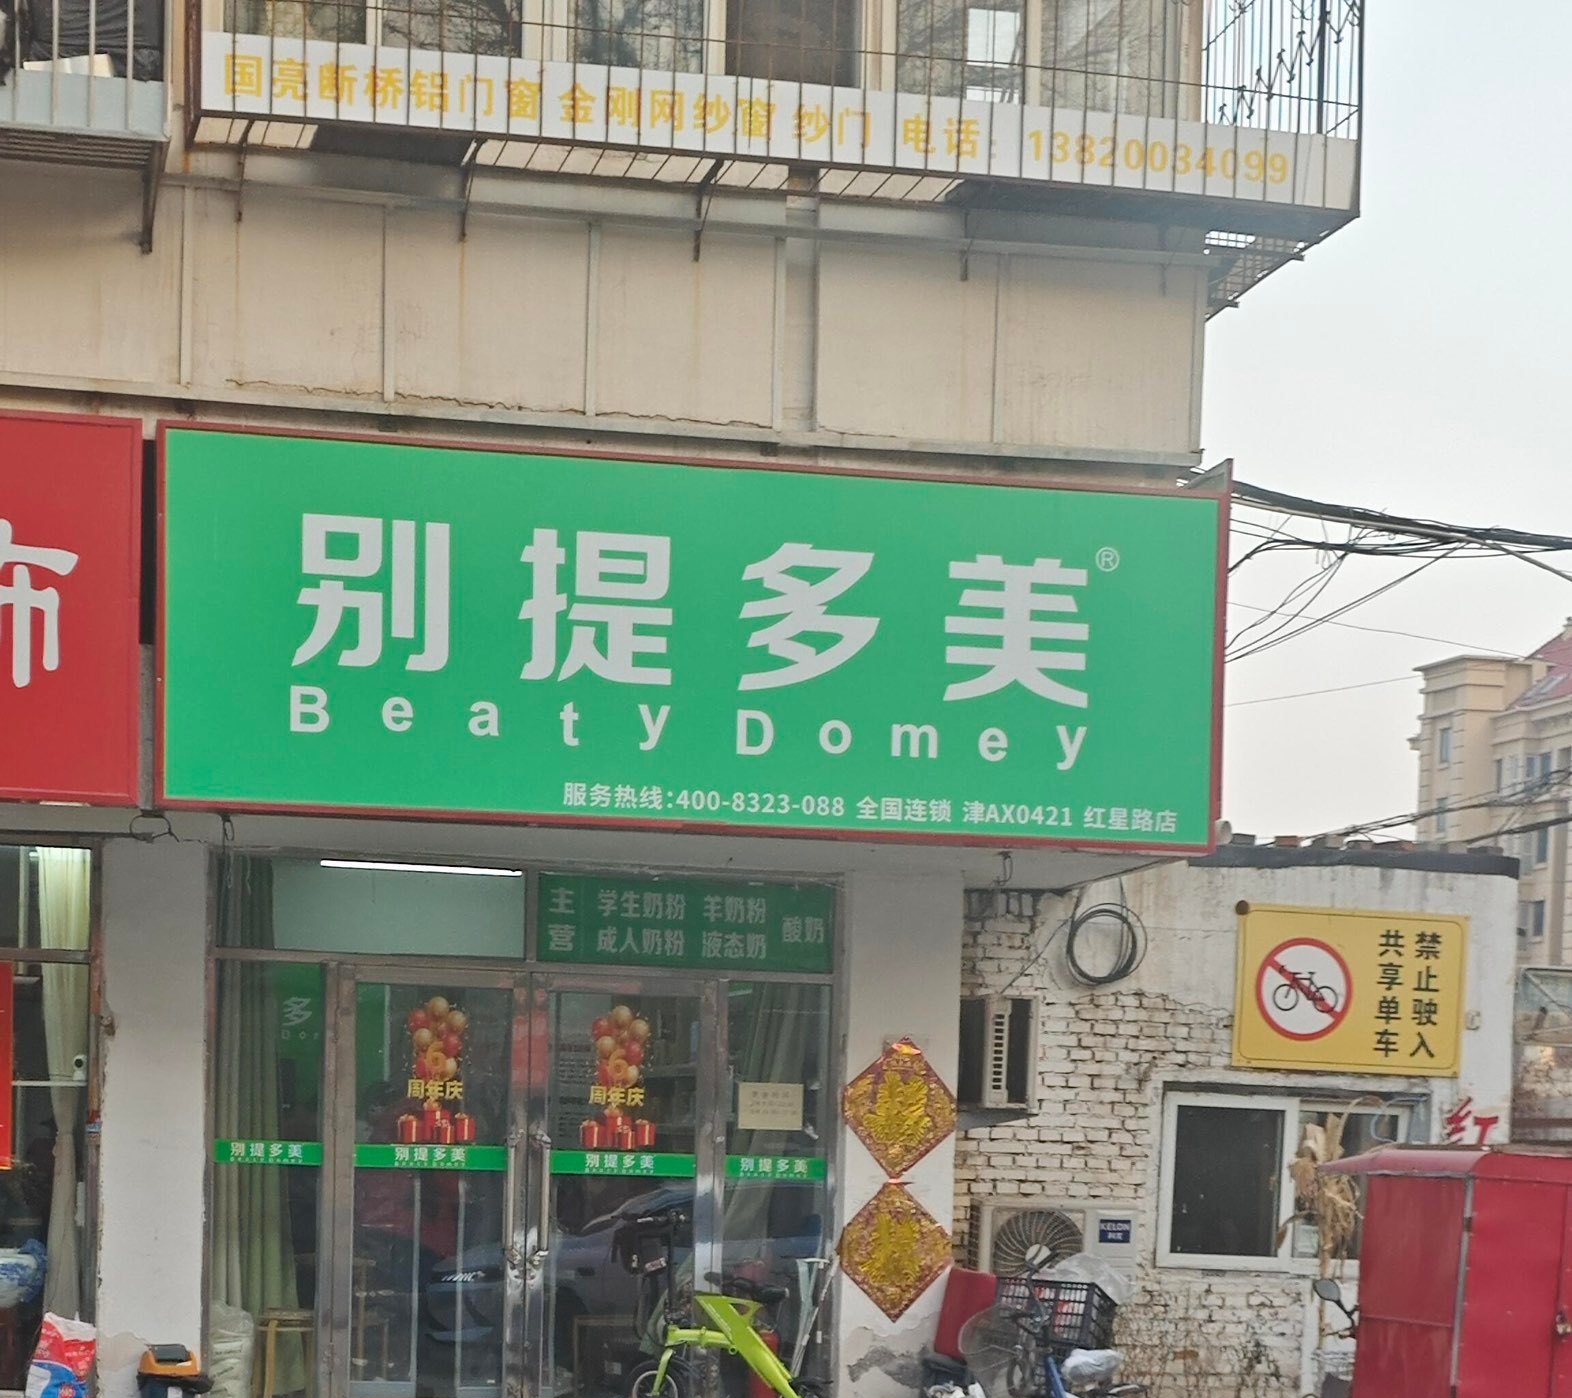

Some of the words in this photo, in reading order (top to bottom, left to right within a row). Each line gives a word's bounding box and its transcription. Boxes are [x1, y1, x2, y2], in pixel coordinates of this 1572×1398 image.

[224, 54, 541, 120] 国亮断桥铝门窗
[558, 82, 777, 138] 金刚网纱窗
[793, 104, 872, 149] 纱门
[1029, 129, 1289, 185] 13820034099
[291, 513, 1090, 709] 别提多美
[289, 685, 671, 751] Beaty
[736, 709, 1088, 771] Domey
[563, 782, 845, 816] 服务热线:400-8323-088
[856, 796, 952, 823] 全国连锁
[962, 801, 1073, 826] 津AX0421
[1083, 806, 1178, 833] 红星路店
[549, 887, 576, 952] 主营
[597, 889, 686, 920] 学生奶粉
[702, 895, 767, 924] 羊奶粉
[596, 926, 685, 956] 成人奶粉
[701, 930, 767, 960] 液态奶
[781, 916, 825, 944] 酸奶
[1373, 929, 1405, 1058] 共享单车
[1409, 931, 1442, 1059] 禁止驶入
[407, 1079, 464, 1100] 周年庆
[588, 1085, 645, 1107] 周年庆
[230, 1142, 303, 1159] 别提多美
[394, 1147, 466, 1162] 别提多美
[585, 1153, 655, 1169] 别提多美
[740, 1157, 808, 1174] 别提多美
